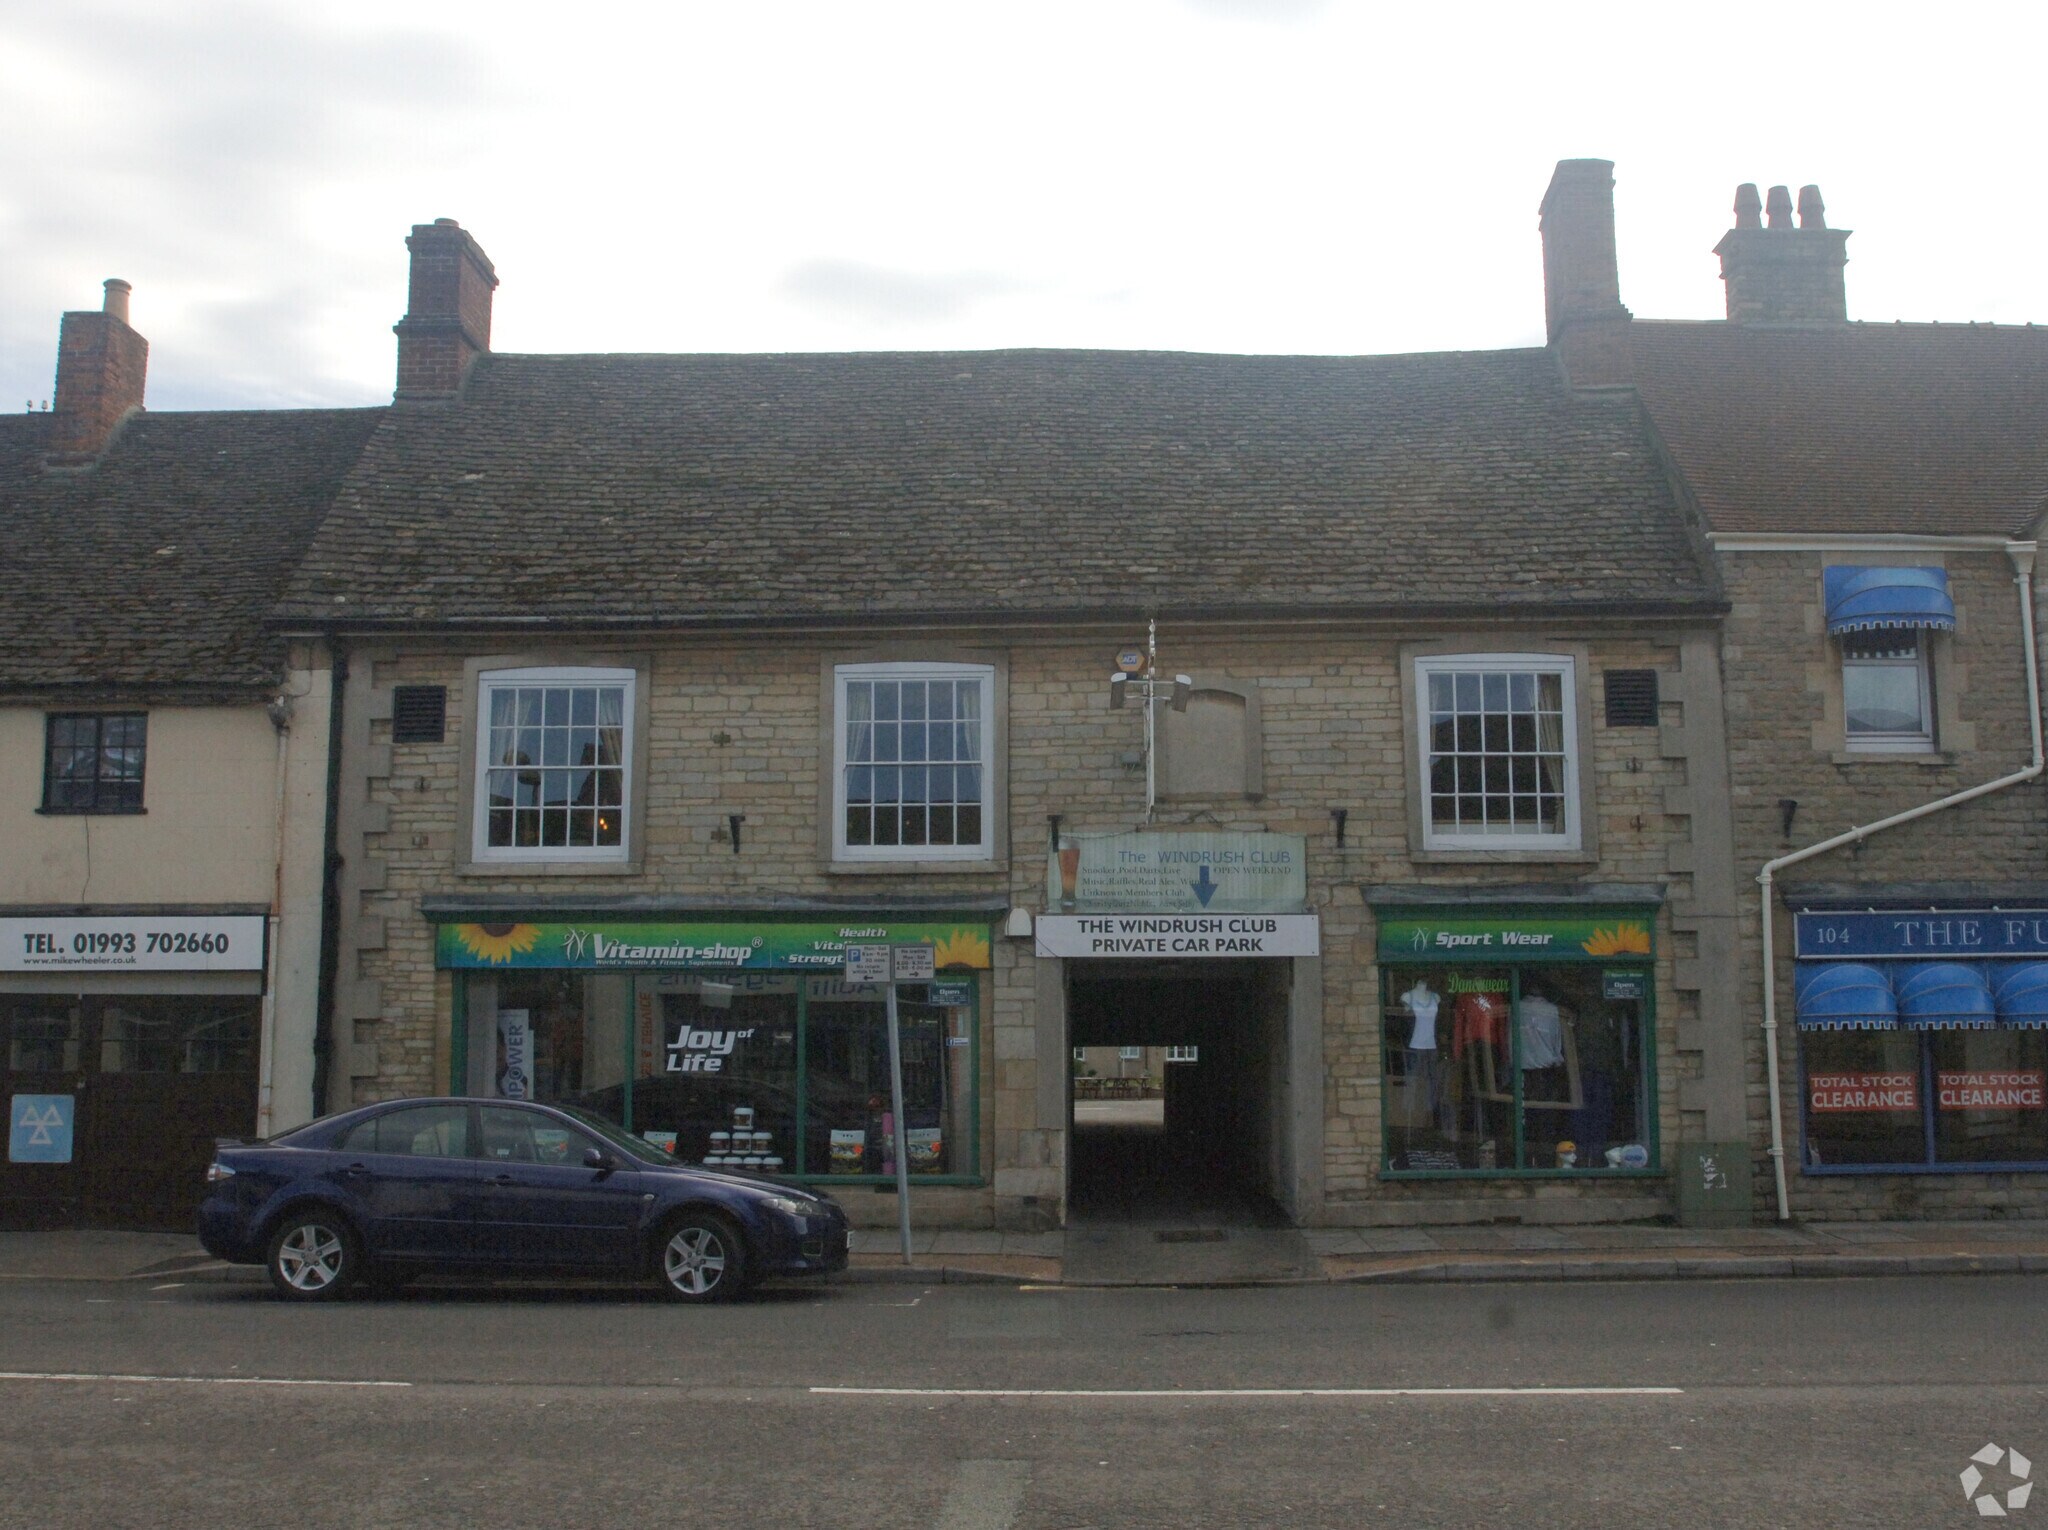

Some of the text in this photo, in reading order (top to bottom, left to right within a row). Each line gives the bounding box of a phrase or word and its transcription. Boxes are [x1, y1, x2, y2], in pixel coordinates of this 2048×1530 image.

[1118, 850, 1291, 864] The WINDRUSH CLUB
[1213, 866, 1291, 875] OPEN WEEKEND
[1082, 888, 1185, 897] Unknown Members Club
[839, 928, 887, 937] Health
[1077, 919, 1277, 933] THE WINDRUSH CLUB
[1894, 920, 1982, 946] THE
[24, 932, 229, 954] TEL. 01993 702660
[1436, 932, 1553, 949] Sport Wear
[1817, 928, 1850, 944] 104
[1092, 938, 1264, 952] PRIVATE CAR PARK
[23, 955, 137, 965] www.mikewheeler.co.uk
[1614, 981, 1635, 989] Open
[667, 1025, 756, 1055] Joy of
[666, 1054, 722, 1072] Life
[1810, 1075, 1912, 1088] TOTAL STOCK
[1938, 1074, 2038, 1086] TOTAL STOCK
[1811, 1091, 1914, 1108] CLEARANCE
[1939, 1089, 2041, 1106] CLEARANCE
